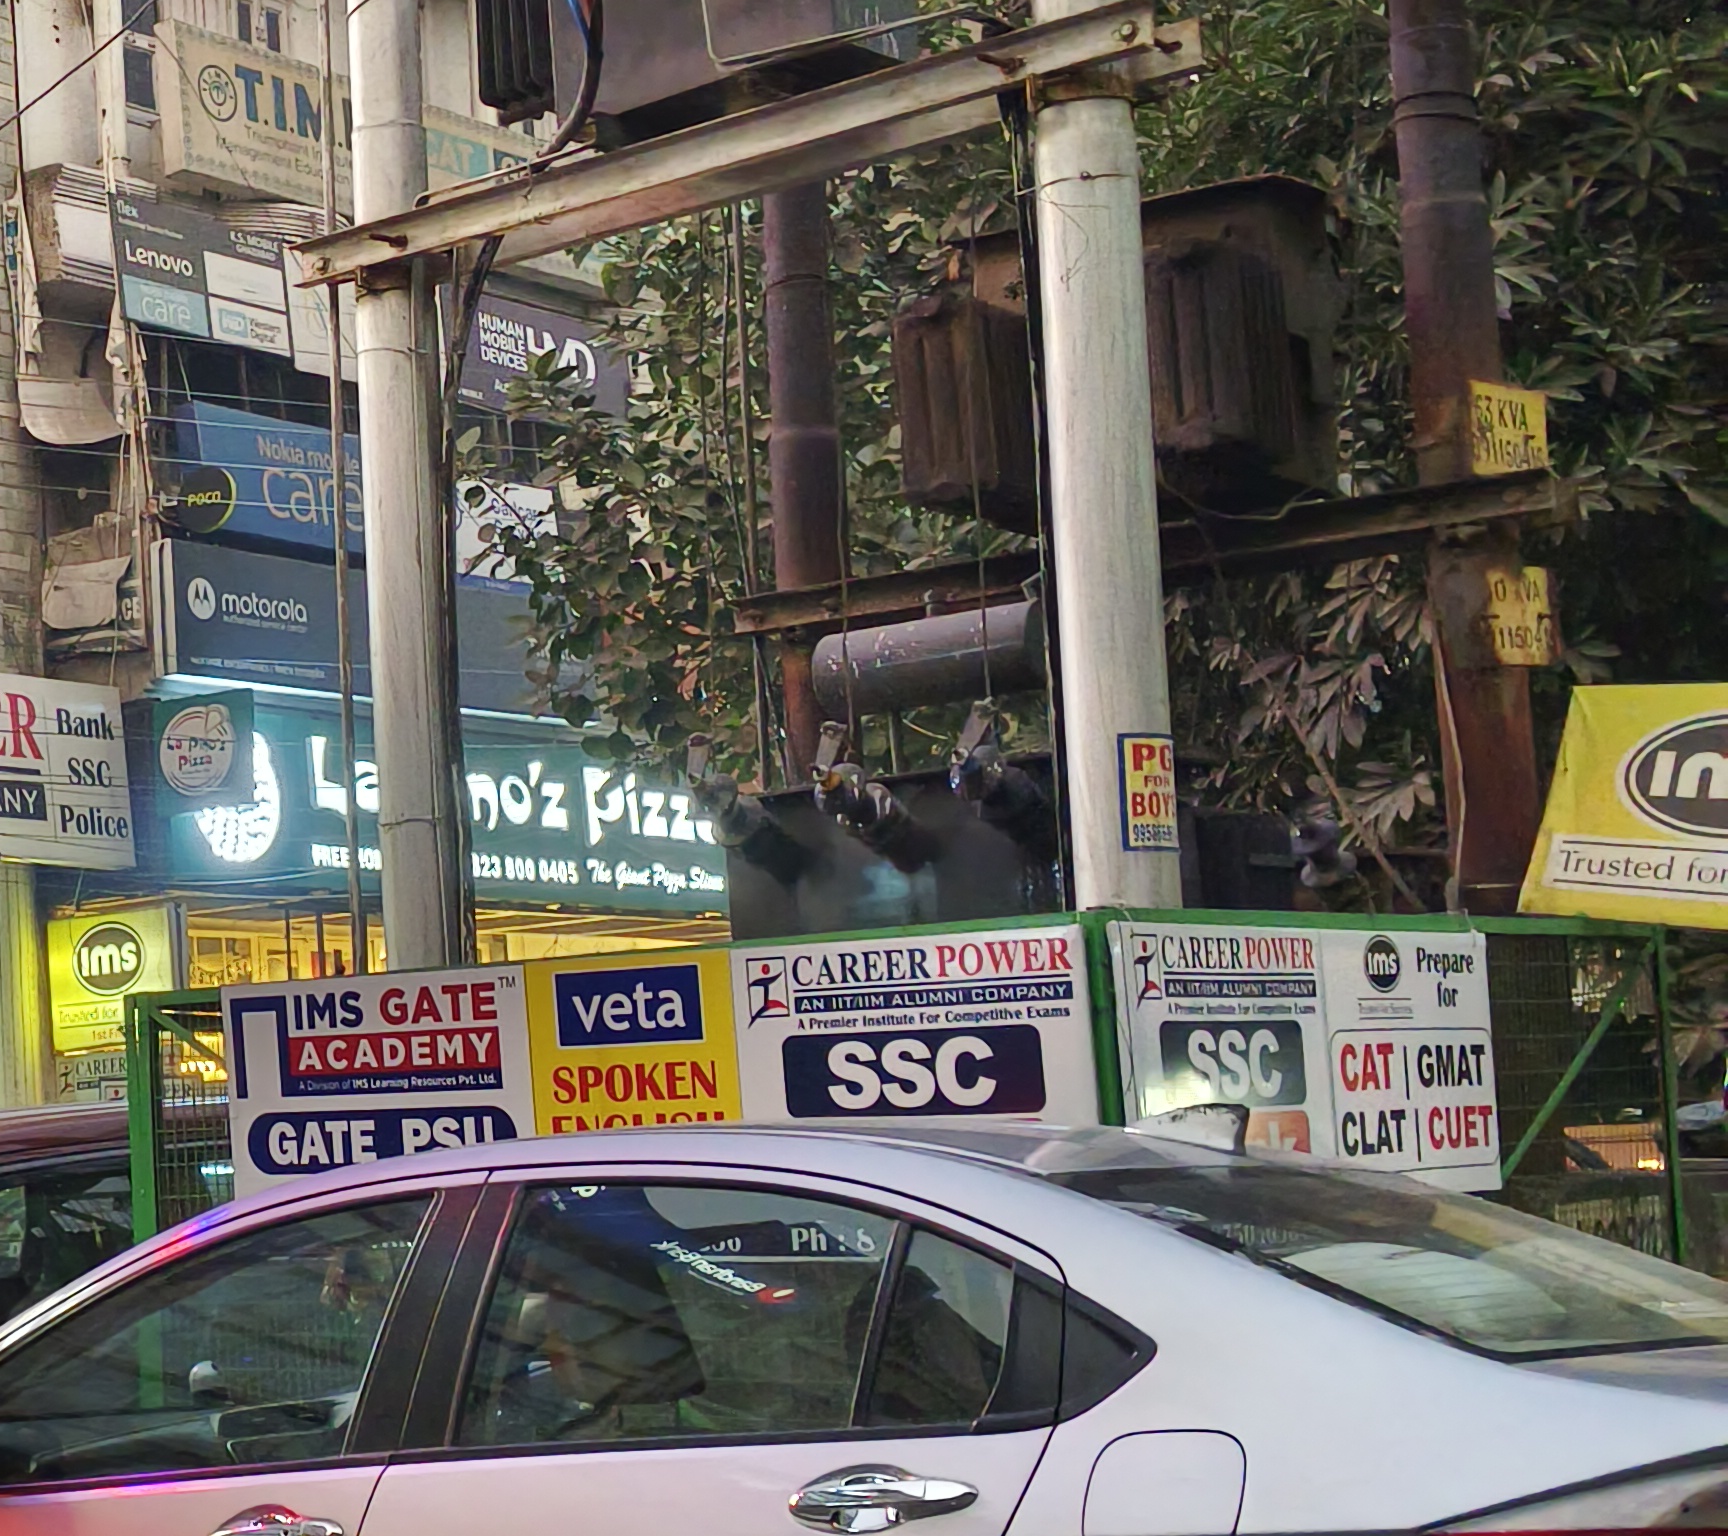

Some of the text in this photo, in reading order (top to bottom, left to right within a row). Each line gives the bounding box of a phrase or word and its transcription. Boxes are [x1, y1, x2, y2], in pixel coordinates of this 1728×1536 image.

[123, 238, 194, 278] Lenovo
[478, 311, 525, 340] HUMAN
[479, 328, 526, 357] MOBILE
[480, 345, 529, 373] DEVICES
[256, 433, 305, 466] Nokia
[221, 592, 309, 624] motorola
[54, 707, 115, 742] Bank
[59, 803, 129, 840] Police
[1559, 849, 1675, 882] Trusted
[791, 937, 1073, 987] CAREER POWER
[1160, 935, 1315, 971] CAREER POWER
[1416, 947, 1475, 978] Prepare
[293, 981, 498, 1031] IMS GATE
[571, 981, 687, 1034] veta
[970, 983, 1068, 1003] COMPANY
[1436, 980, 1459, 1008] for
[297, 1031, 494, 1073] ACADEMY
[1187, 1028, 1283, 1100] SSC
[1339, 1042, 1486, 1092] CAT GMAT
[551, 1059, 719, 1104] SPOKEN
[827, 1035, 998, 1112] SSC
[268, 1119, 378, 1166] GATE
[1341, 1105, 1494, 1157] CLAT CUET
